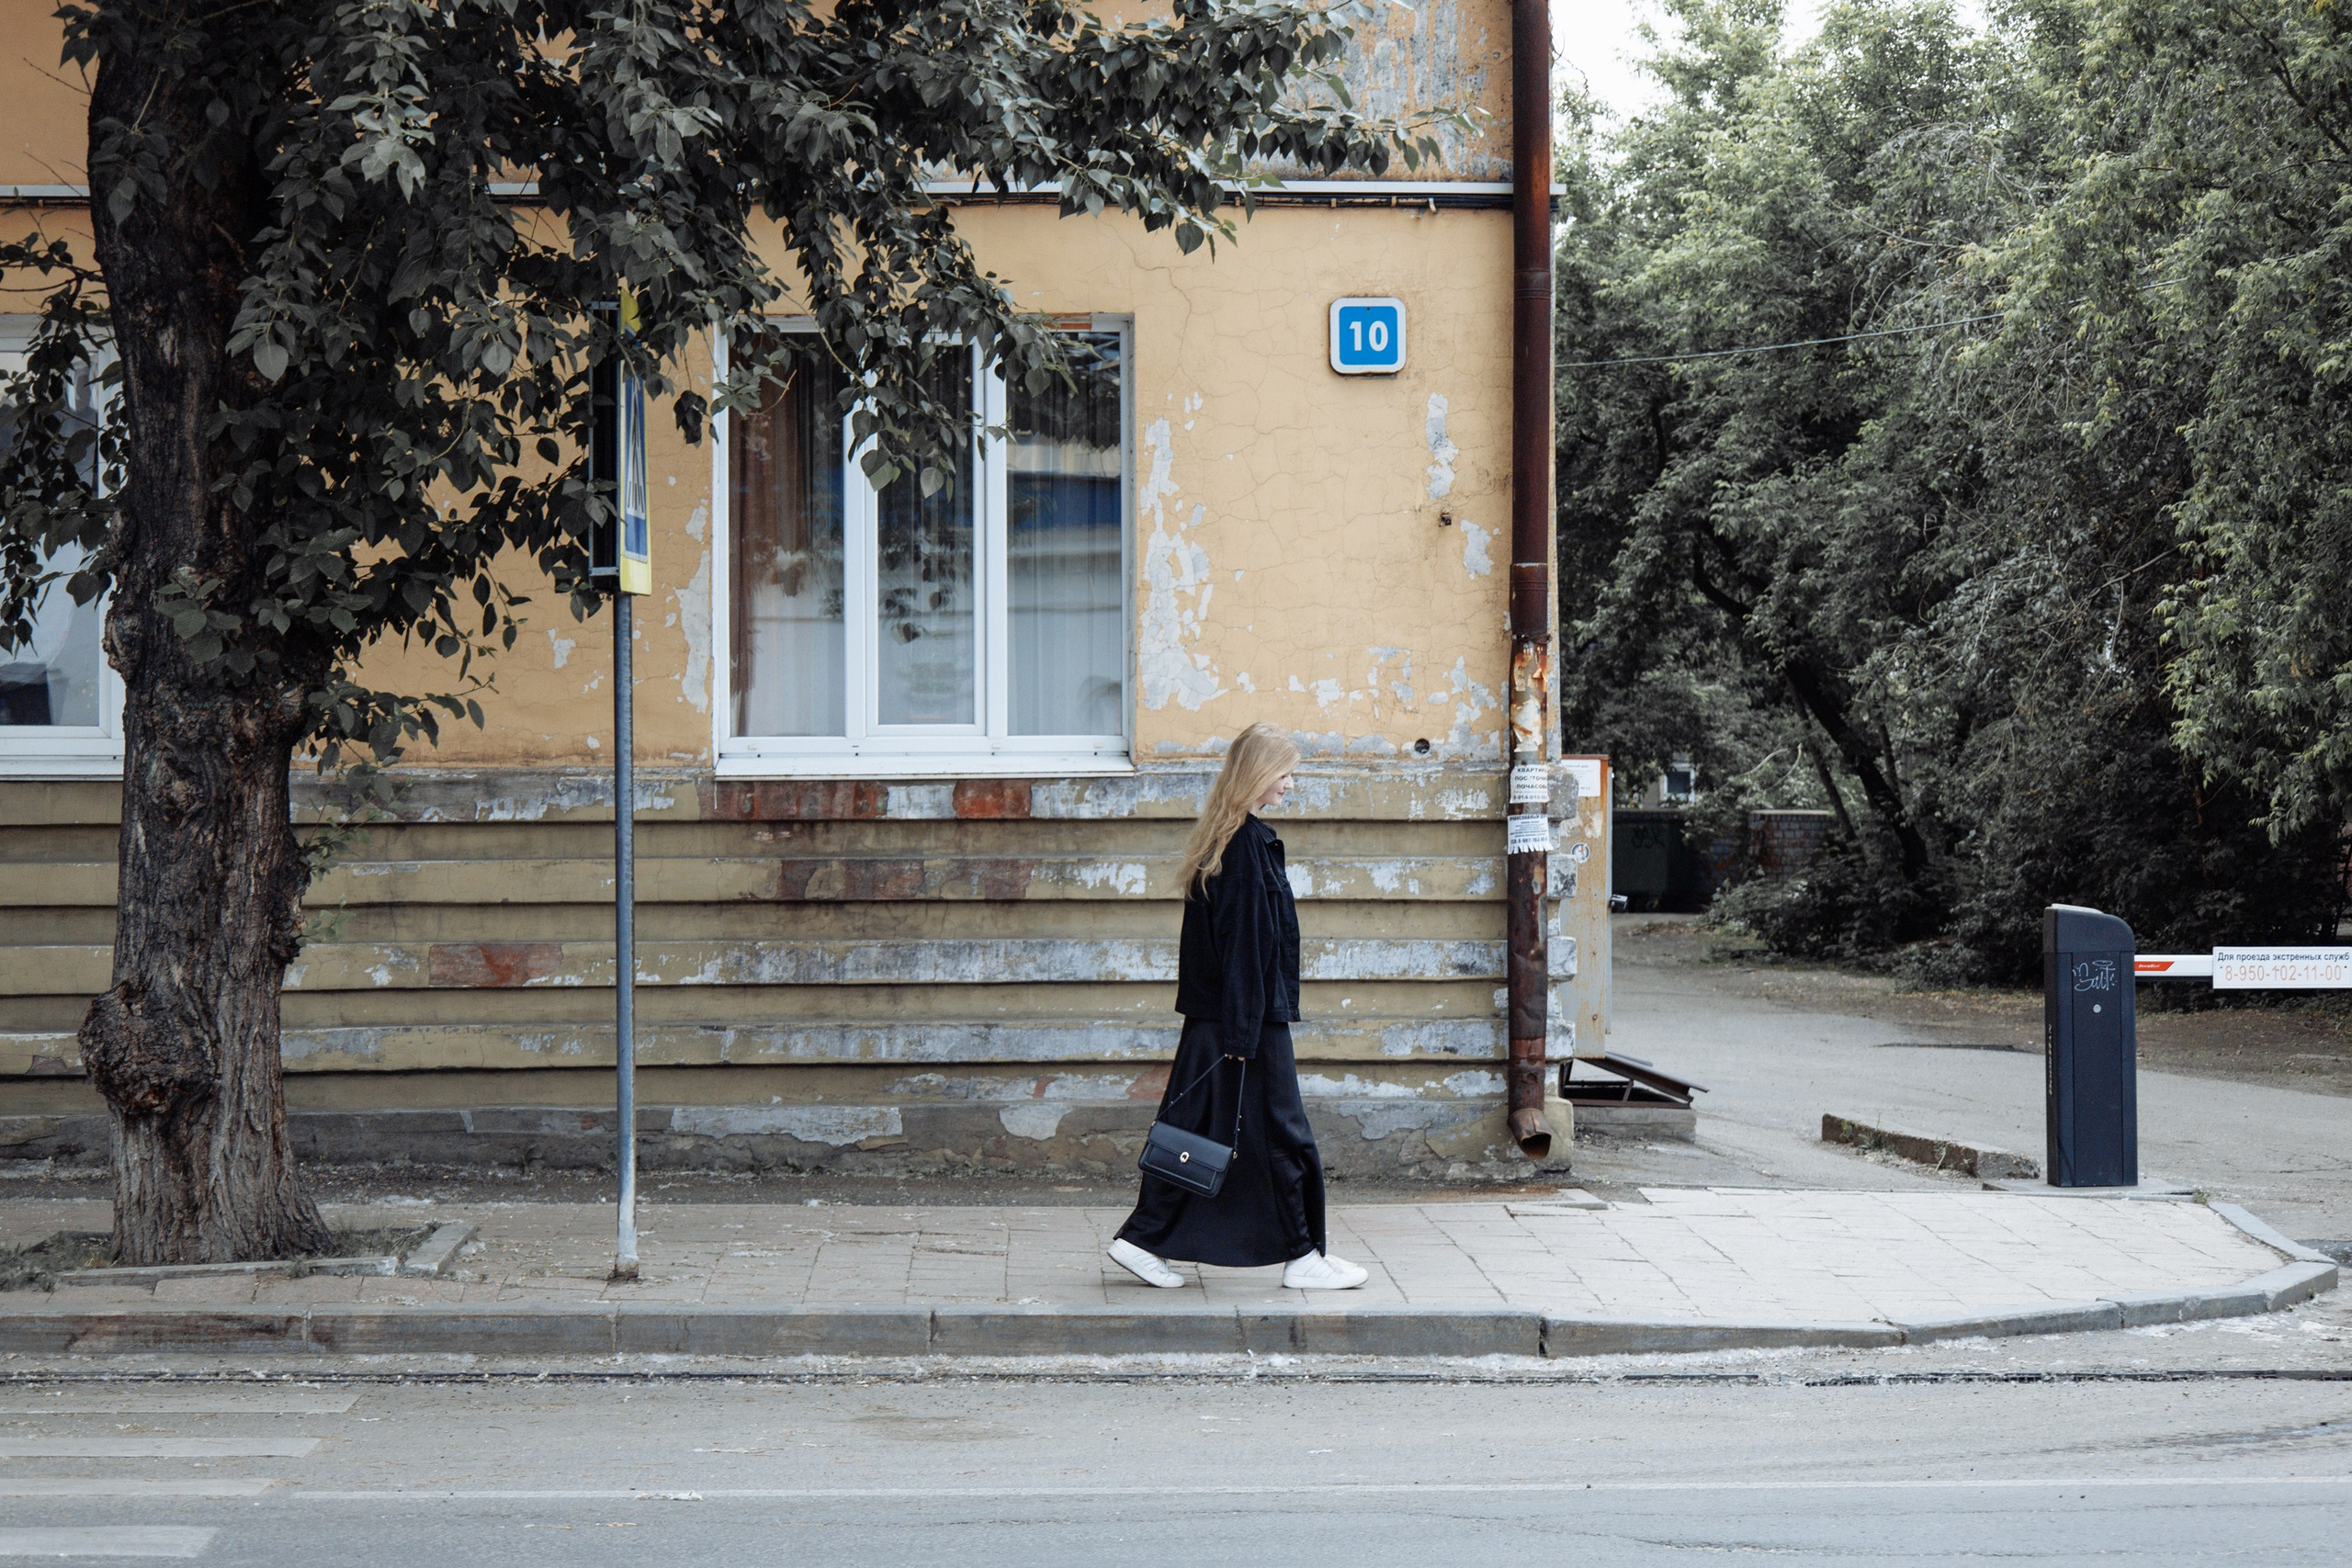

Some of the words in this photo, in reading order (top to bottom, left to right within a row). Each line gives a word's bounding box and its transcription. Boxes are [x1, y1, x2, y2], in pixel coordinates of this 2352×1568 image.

[1349, 321, 1389, 352] 10
[2217, 952, 2234, 962] Для
[2236, 953, 2270, 962] проезда
[2273, 953, 2321, 962] экстренных
[2324, 952, 2350, 962] служб
[2225, 964, 2342, 981] 8-950-102-11-00
